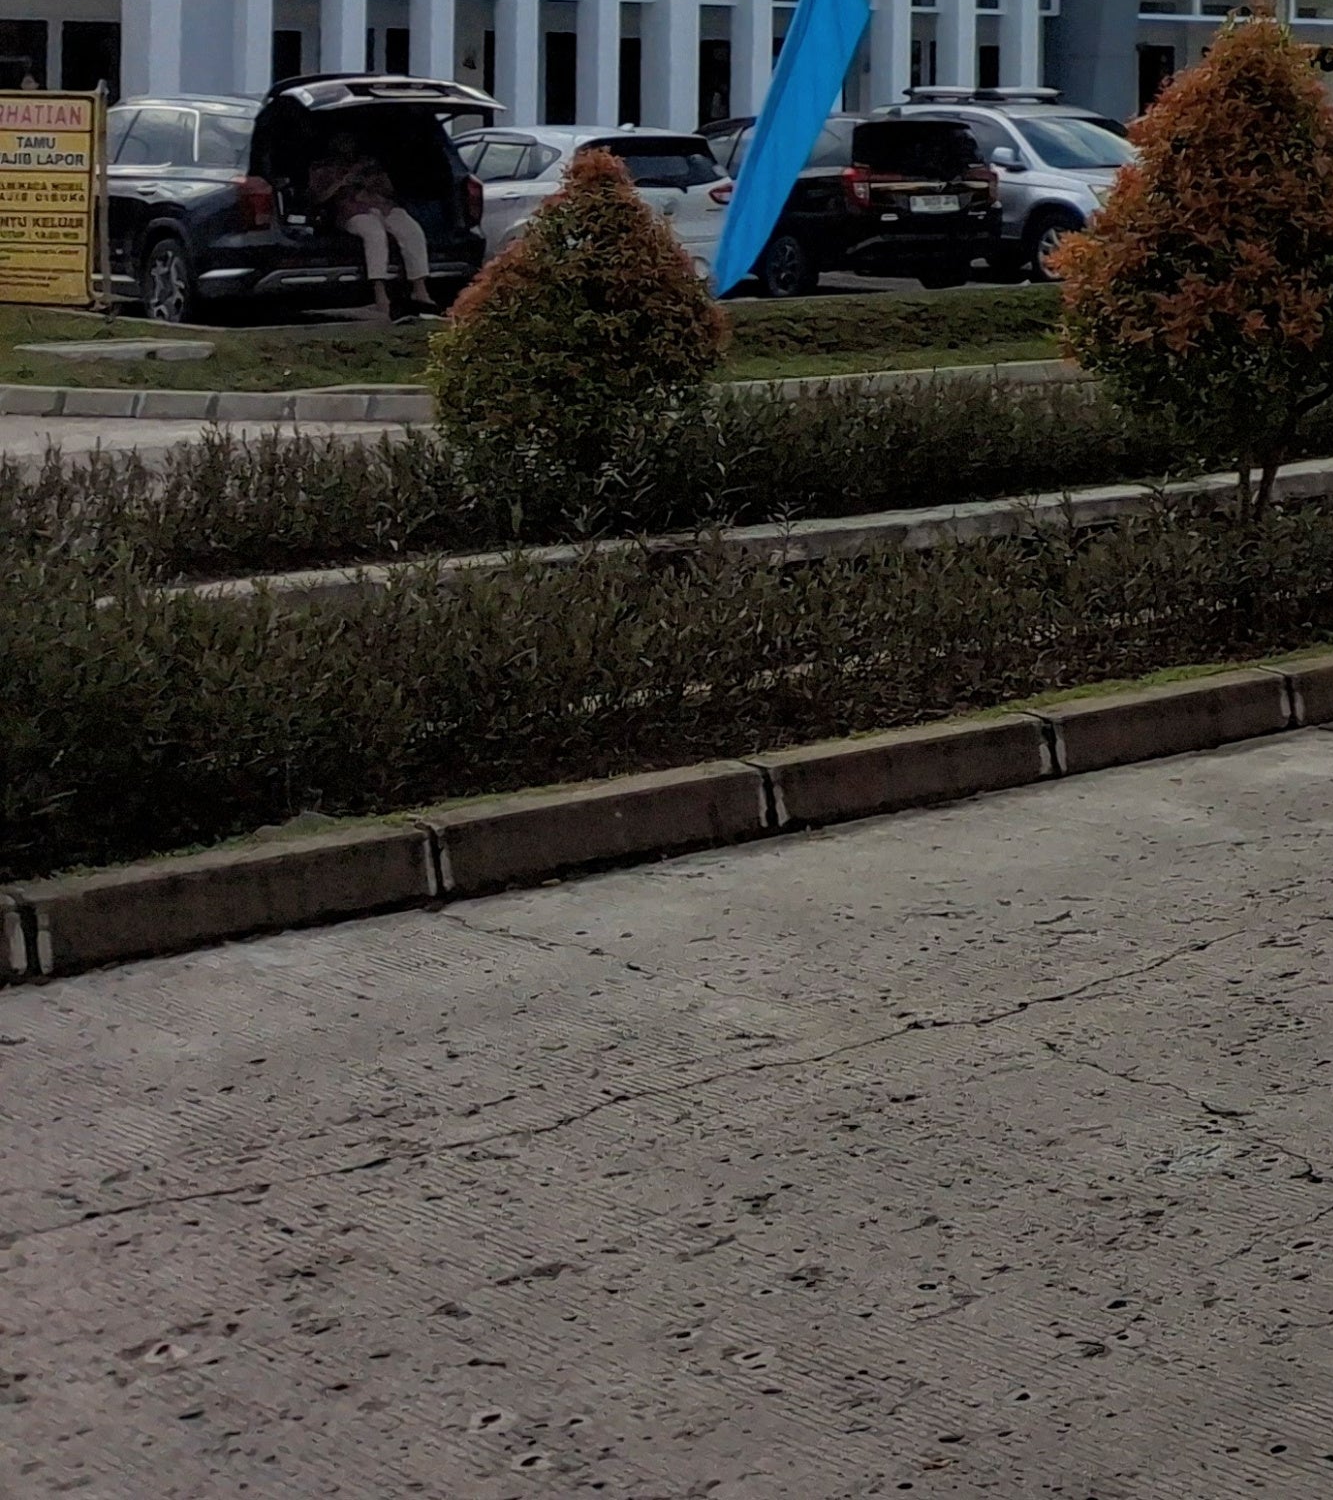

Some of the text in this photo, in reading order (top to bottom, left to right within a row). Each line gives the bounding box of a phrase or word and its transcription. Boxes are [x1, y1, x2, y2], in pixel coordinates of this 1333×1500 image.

[16, 136, 56, 149] TAMU
[0, 153, 85, 166] AJIB LAPOR
